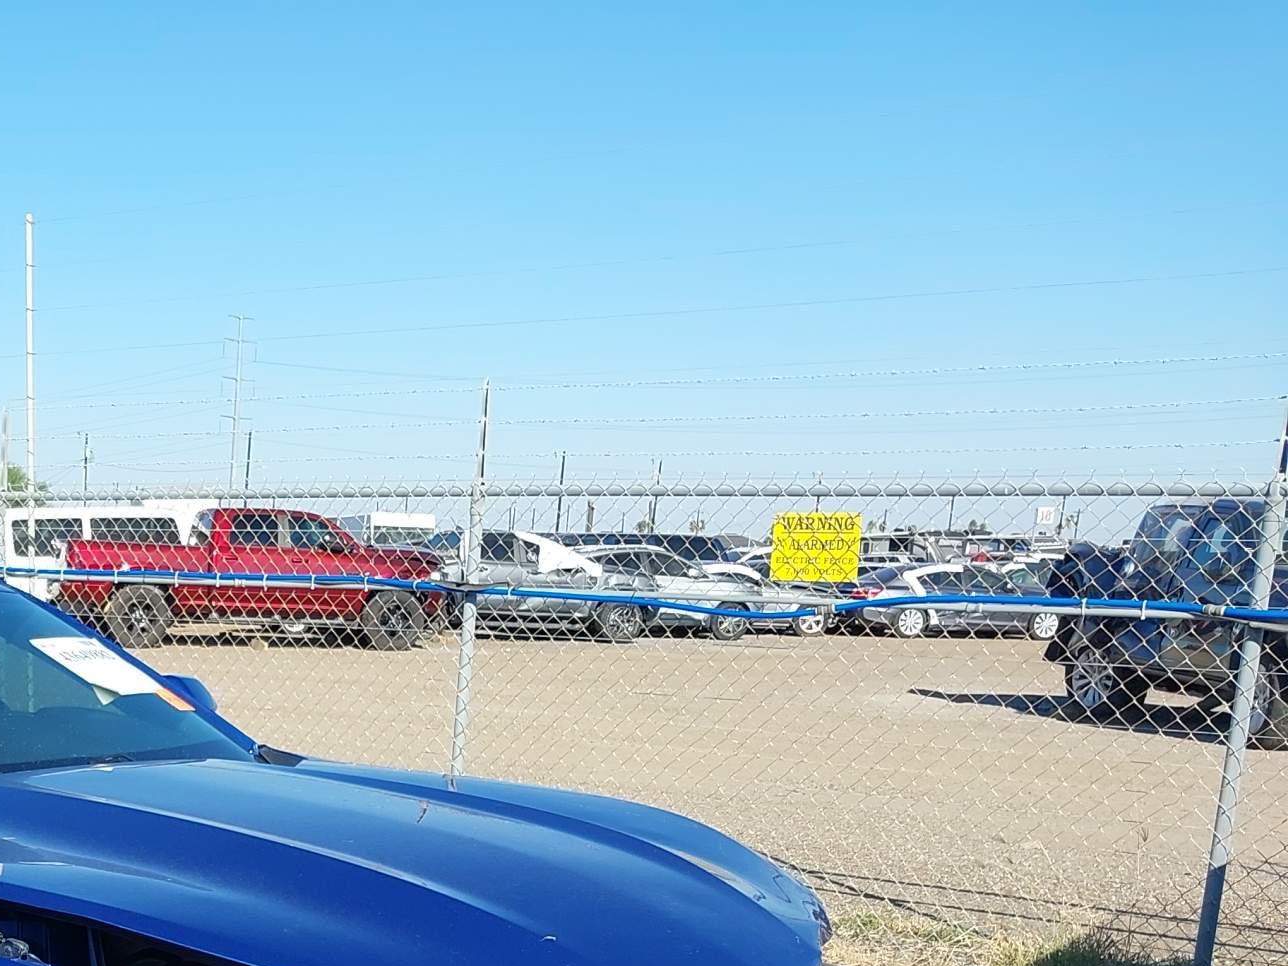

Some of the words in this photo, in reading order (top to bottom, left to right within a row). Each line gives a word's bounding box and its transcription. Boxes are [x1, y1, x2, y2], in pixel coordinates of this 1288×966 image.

[781, 516, 855, 531] WARNING
[789, 538, 844, 551] ALARMED
[775, 556, 822, 565] ELECTRIC
[823, 557, 855, 566] FENCE
[812, 567, 843, 577] VOLTS
